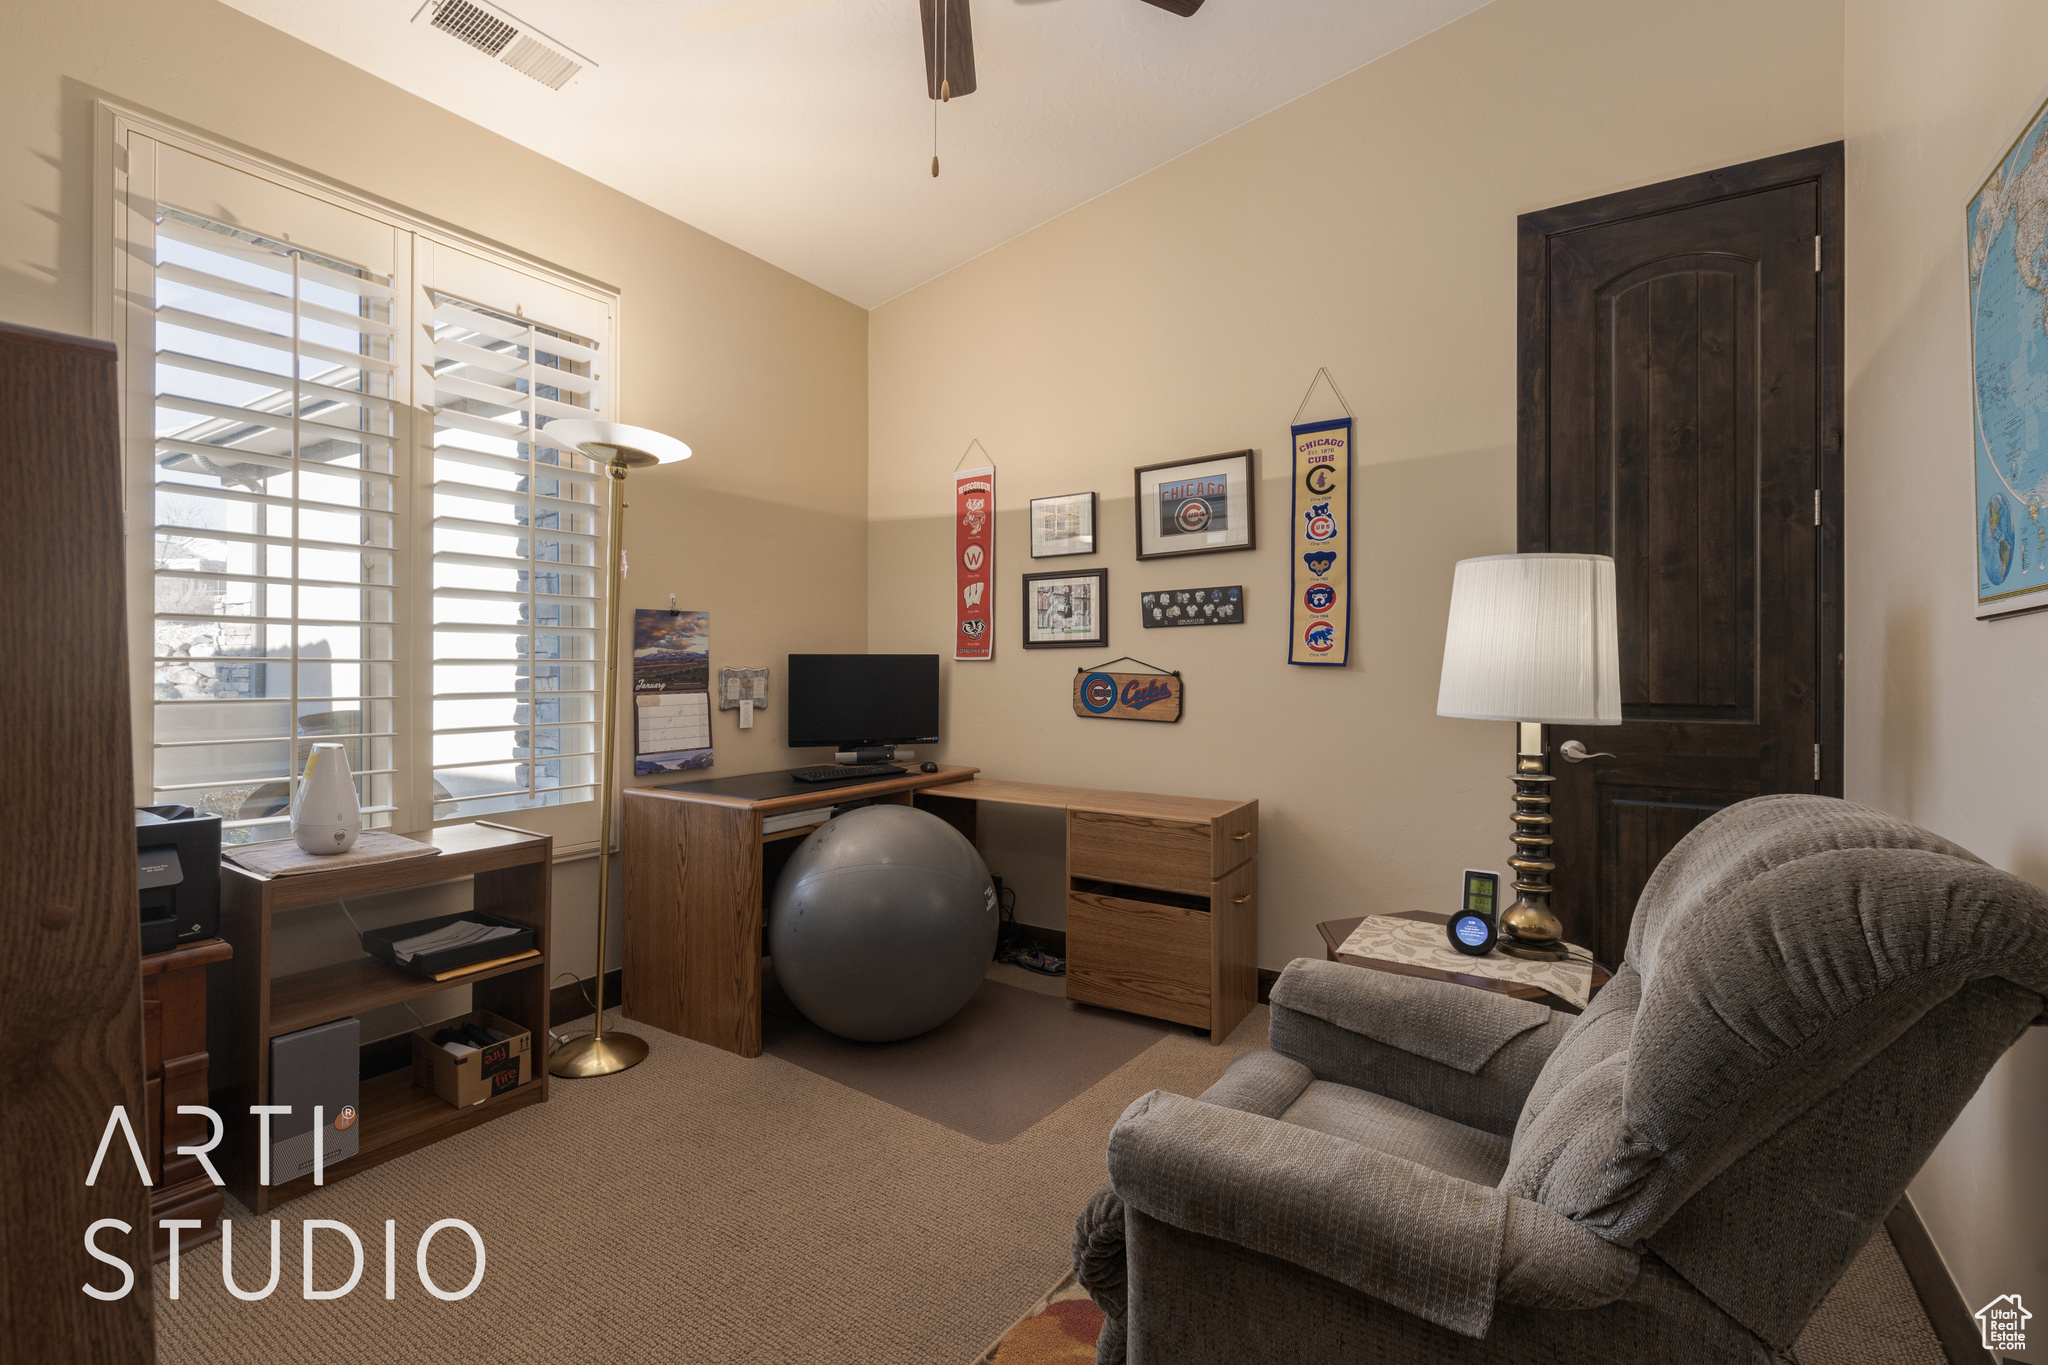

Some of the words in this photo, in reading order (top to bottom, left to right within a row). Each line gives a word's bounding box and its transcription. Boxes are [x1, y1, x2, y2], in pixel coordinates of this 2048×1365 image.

[1299, 438, 1344, 453] CHICAGO
[1308, 454, 1335, 464] CUBS
[958, 481, 991, 495] WISCONSIN
[1162, 482, 1225, 502] CHICAGO
[966, 551, 982, 566] W
[635, 678, 667, 691] January
[1087, 680, 1112, 706] CUBS
[1121, 679, 1172, 710] Cubs
[483, 1047, 507, 1065] fire
[495, 1069, 517, 1087] fire
